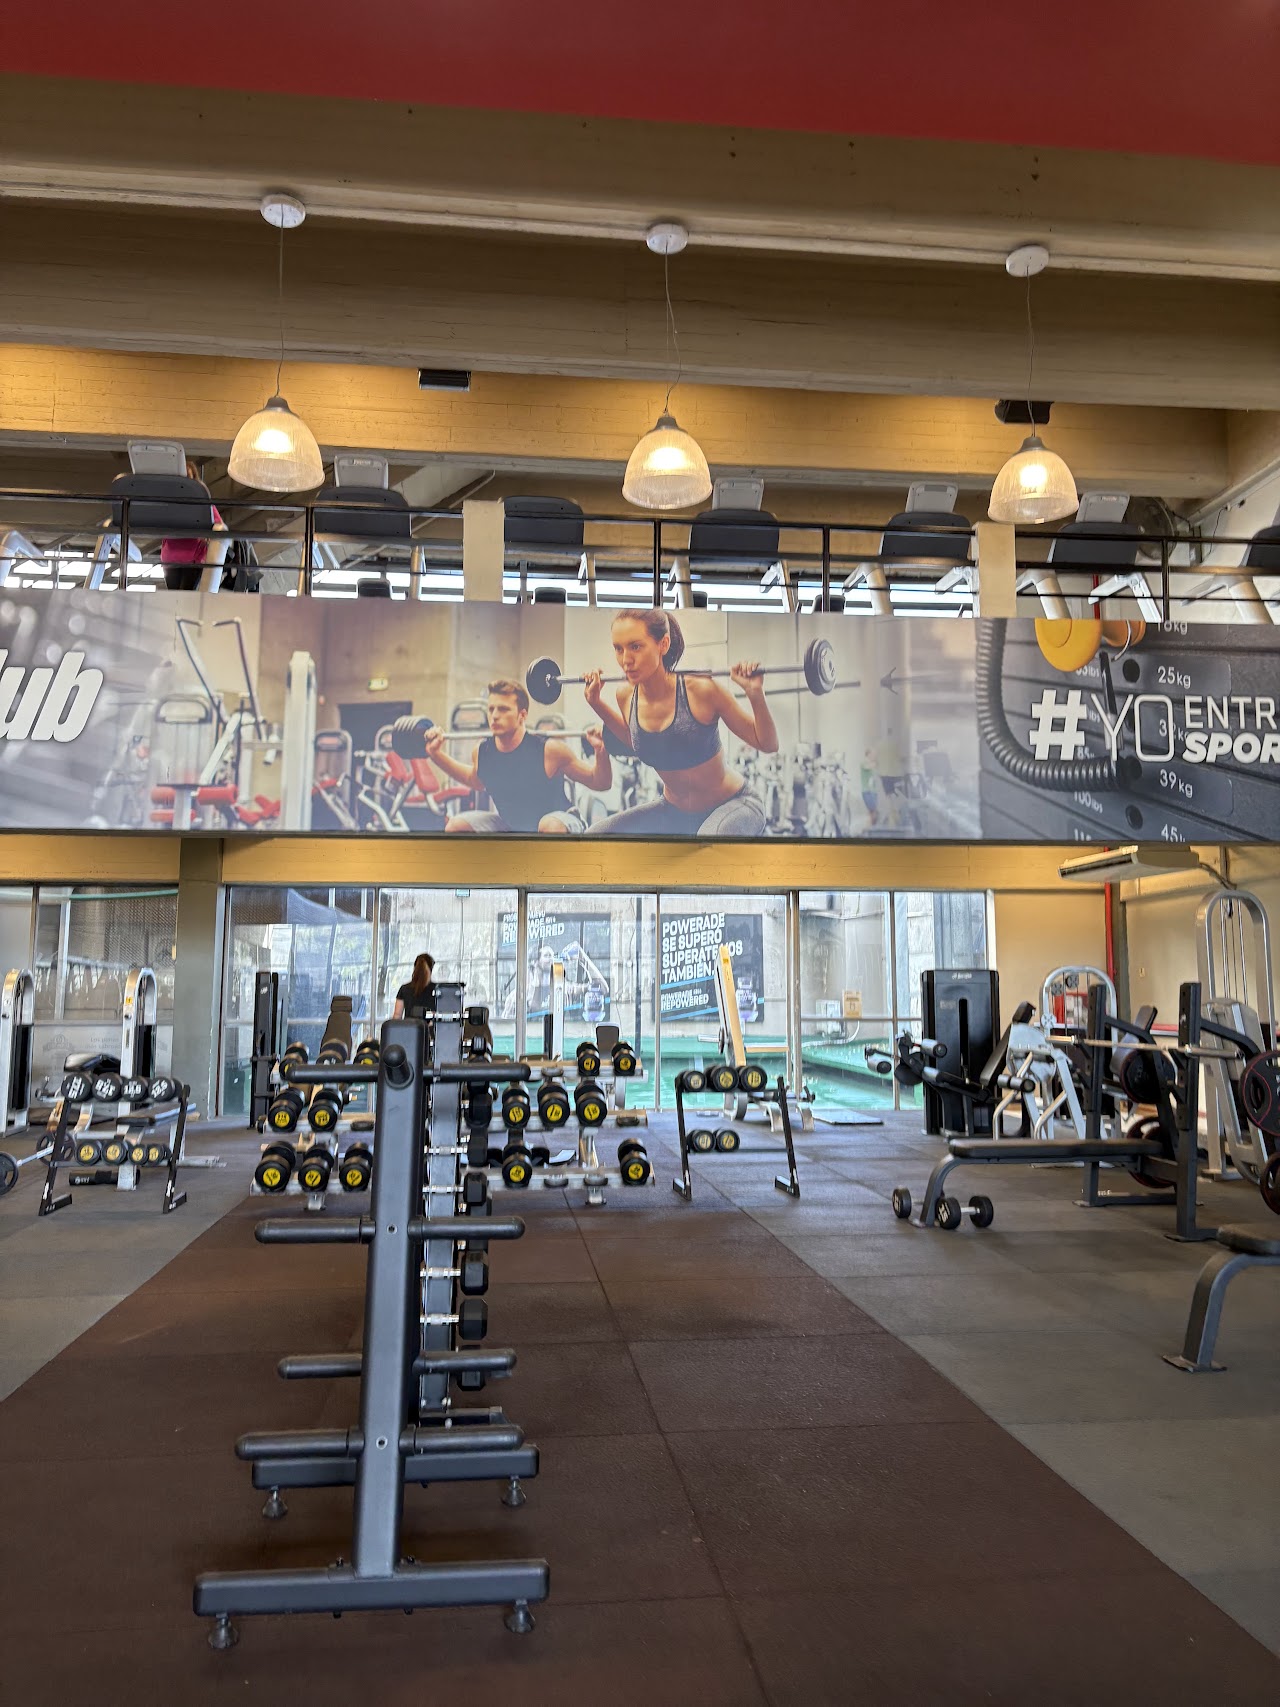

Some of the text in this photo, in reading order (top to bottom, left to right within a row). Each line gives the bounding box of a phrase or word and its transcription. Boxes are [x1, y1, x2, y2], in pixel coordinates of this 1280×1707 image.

[1184, 695, 1278, 730] ENTR
[1182, 731, 1280, 764] SPOR
[662, 912, 725, 938] POWERADE
